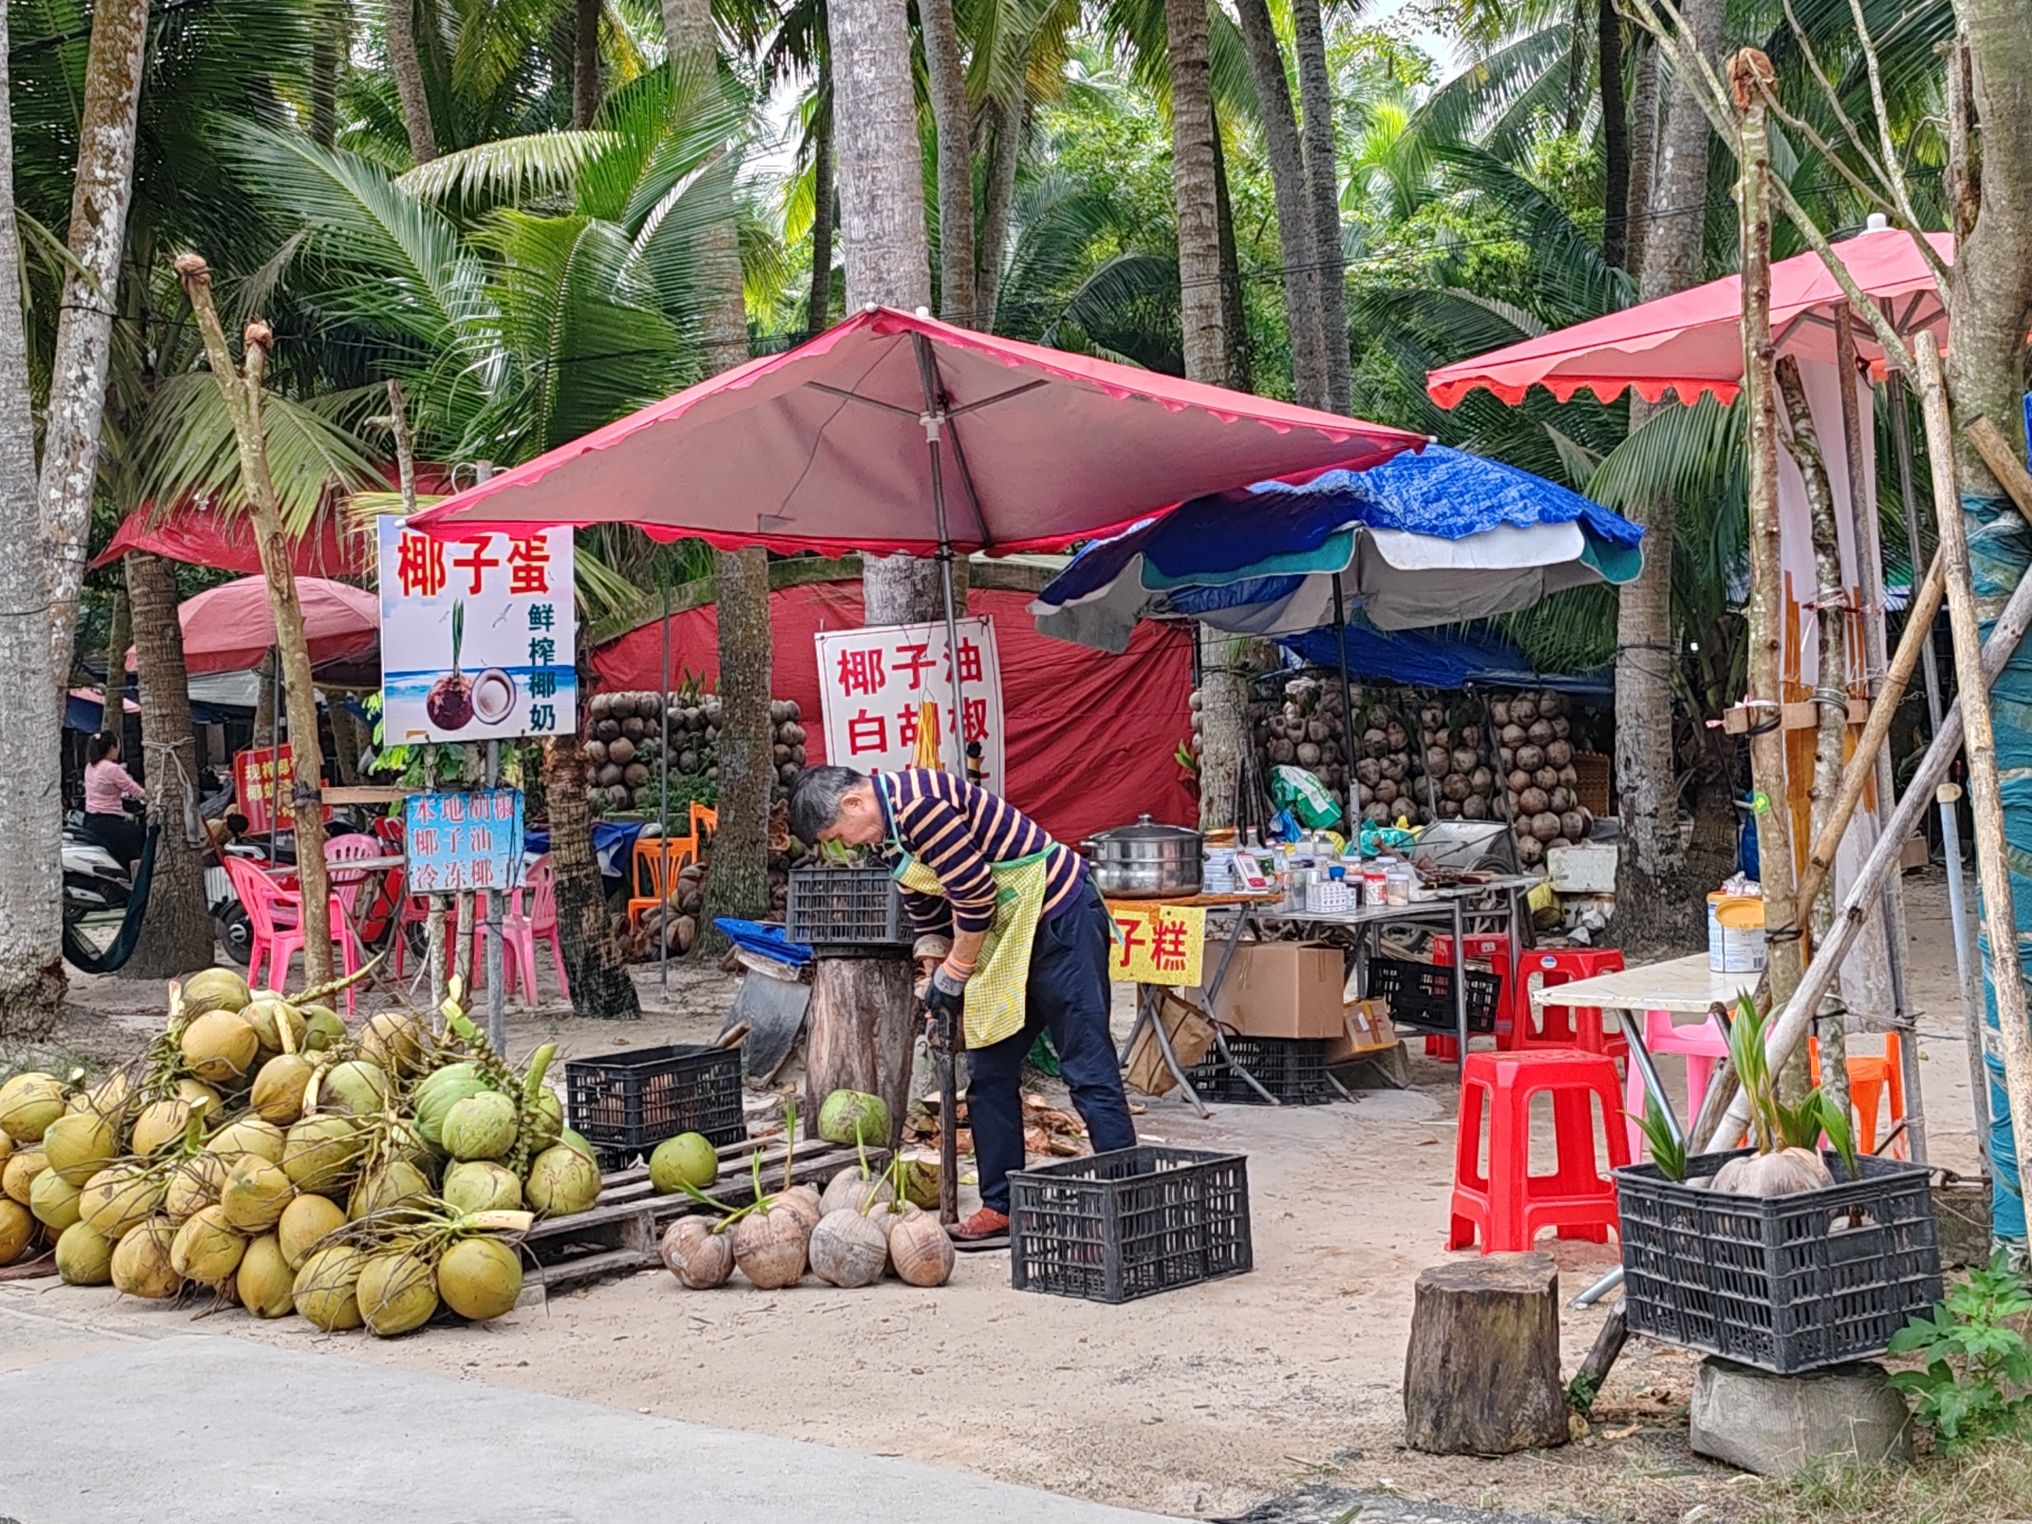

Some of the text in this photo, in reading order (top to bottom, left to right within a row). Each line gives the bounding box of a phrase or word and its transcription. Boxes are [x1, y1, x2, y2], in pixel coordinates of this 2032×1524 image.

[397, 532, 550, 596] 椰子蛋
[528, 603, 557, 731] 鲜榨椰奶
[837, 636, 983, 697] 椰子油
[415, 825, 492, 857] 椰子油
[416, 858, 493, 889] 冷冻椰
[1110, 918, 1188, 971] 子糕
